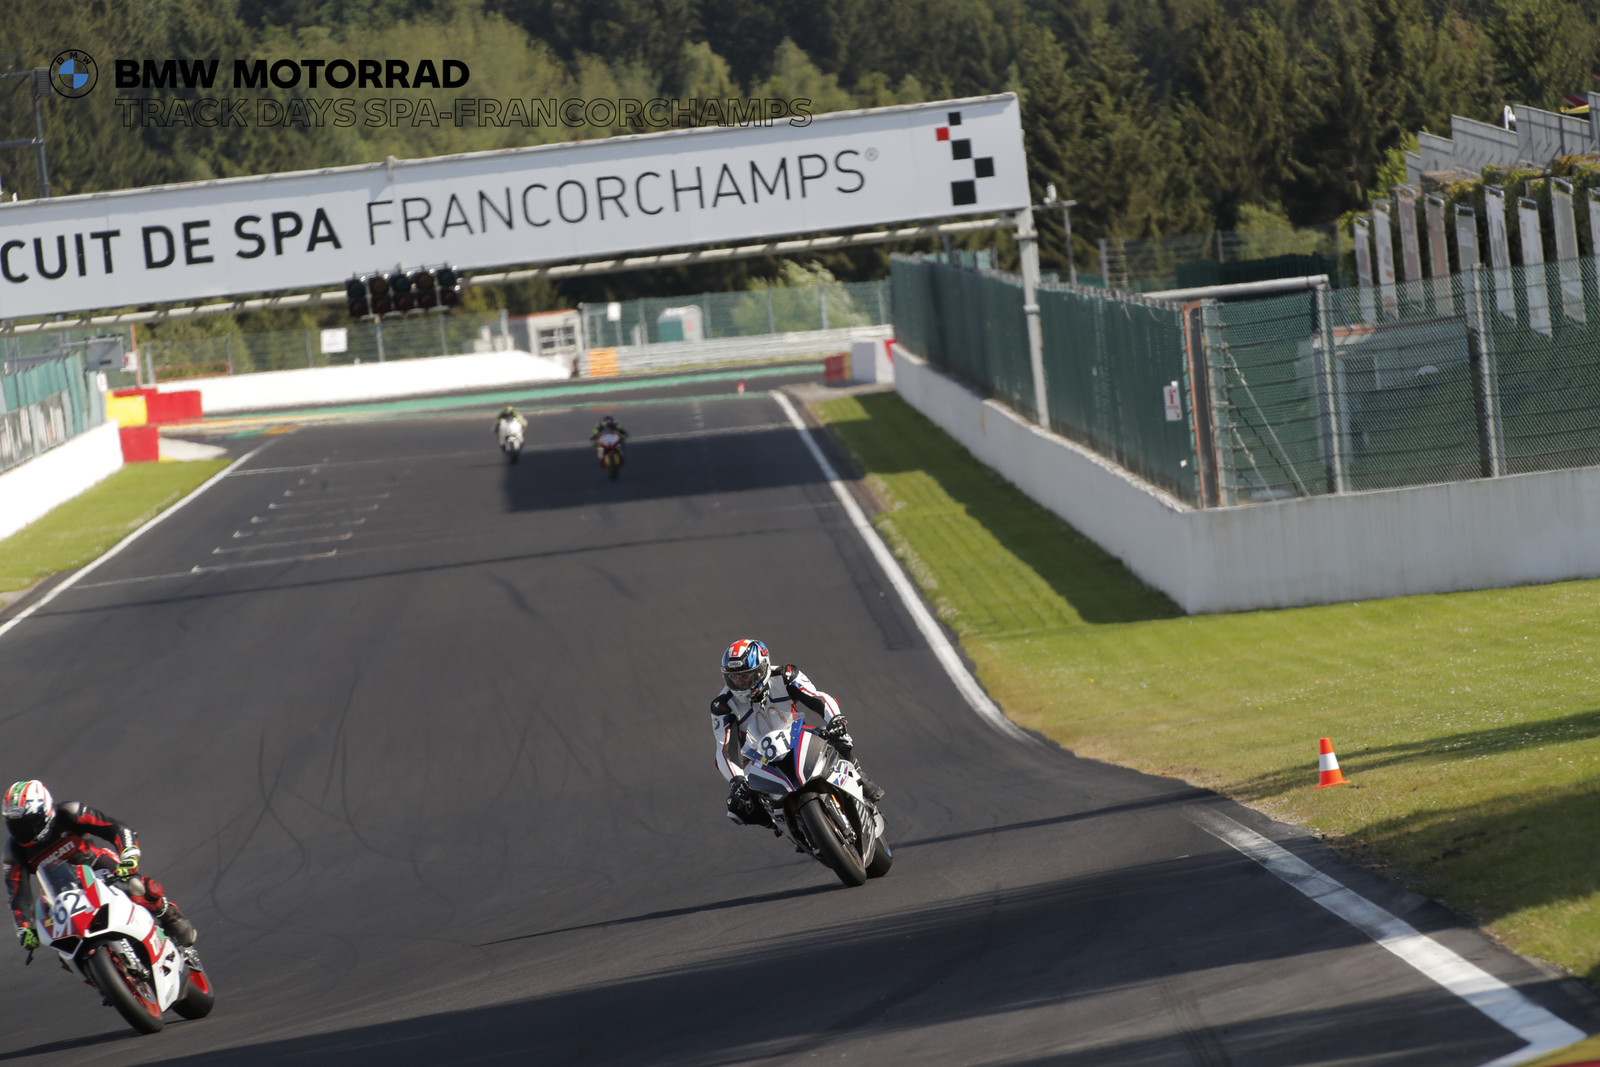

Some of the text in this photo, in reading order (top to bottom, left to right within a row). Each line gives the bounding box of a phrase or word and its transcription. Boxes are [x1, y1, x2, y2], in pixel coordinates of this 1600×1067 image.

[0, 229, 121, 284] CUIT
[142, 220, 214, 270] DE
[234, 208, 343, 259] SPA
[761, 731, 790, 760] 81
